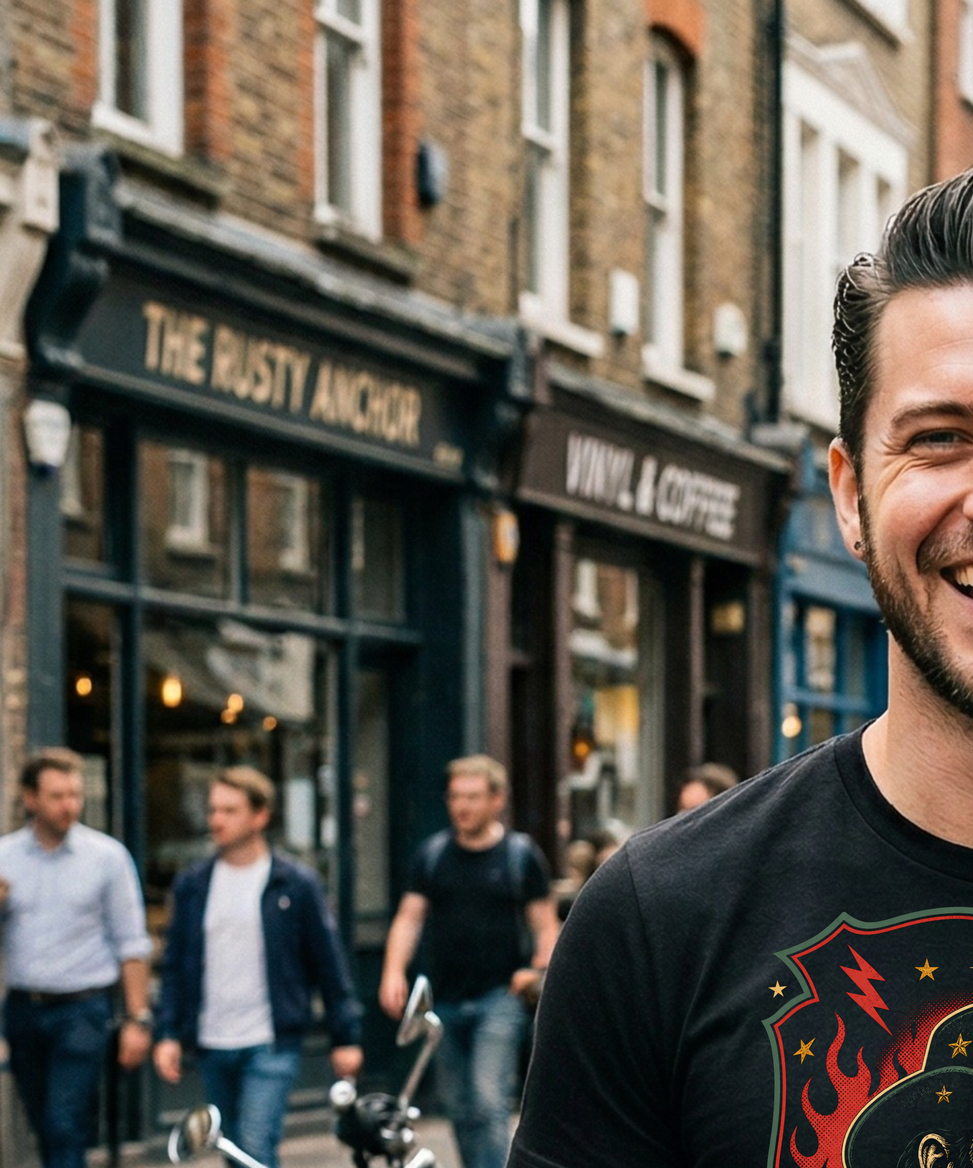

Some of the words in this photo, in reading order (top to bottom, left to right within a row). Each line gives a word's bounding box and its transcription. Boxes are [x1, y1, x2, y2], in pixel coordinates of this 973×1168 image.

[143, 300, 209, 386] THE
[210, 323, 311, 413] RUSTY
[309, 359, 422, 446] ANCHOR
[566, 430, 636, 512] VINYL
[635, 455, 658, 517] &
[656, 463, 741, 541] COFFEE
